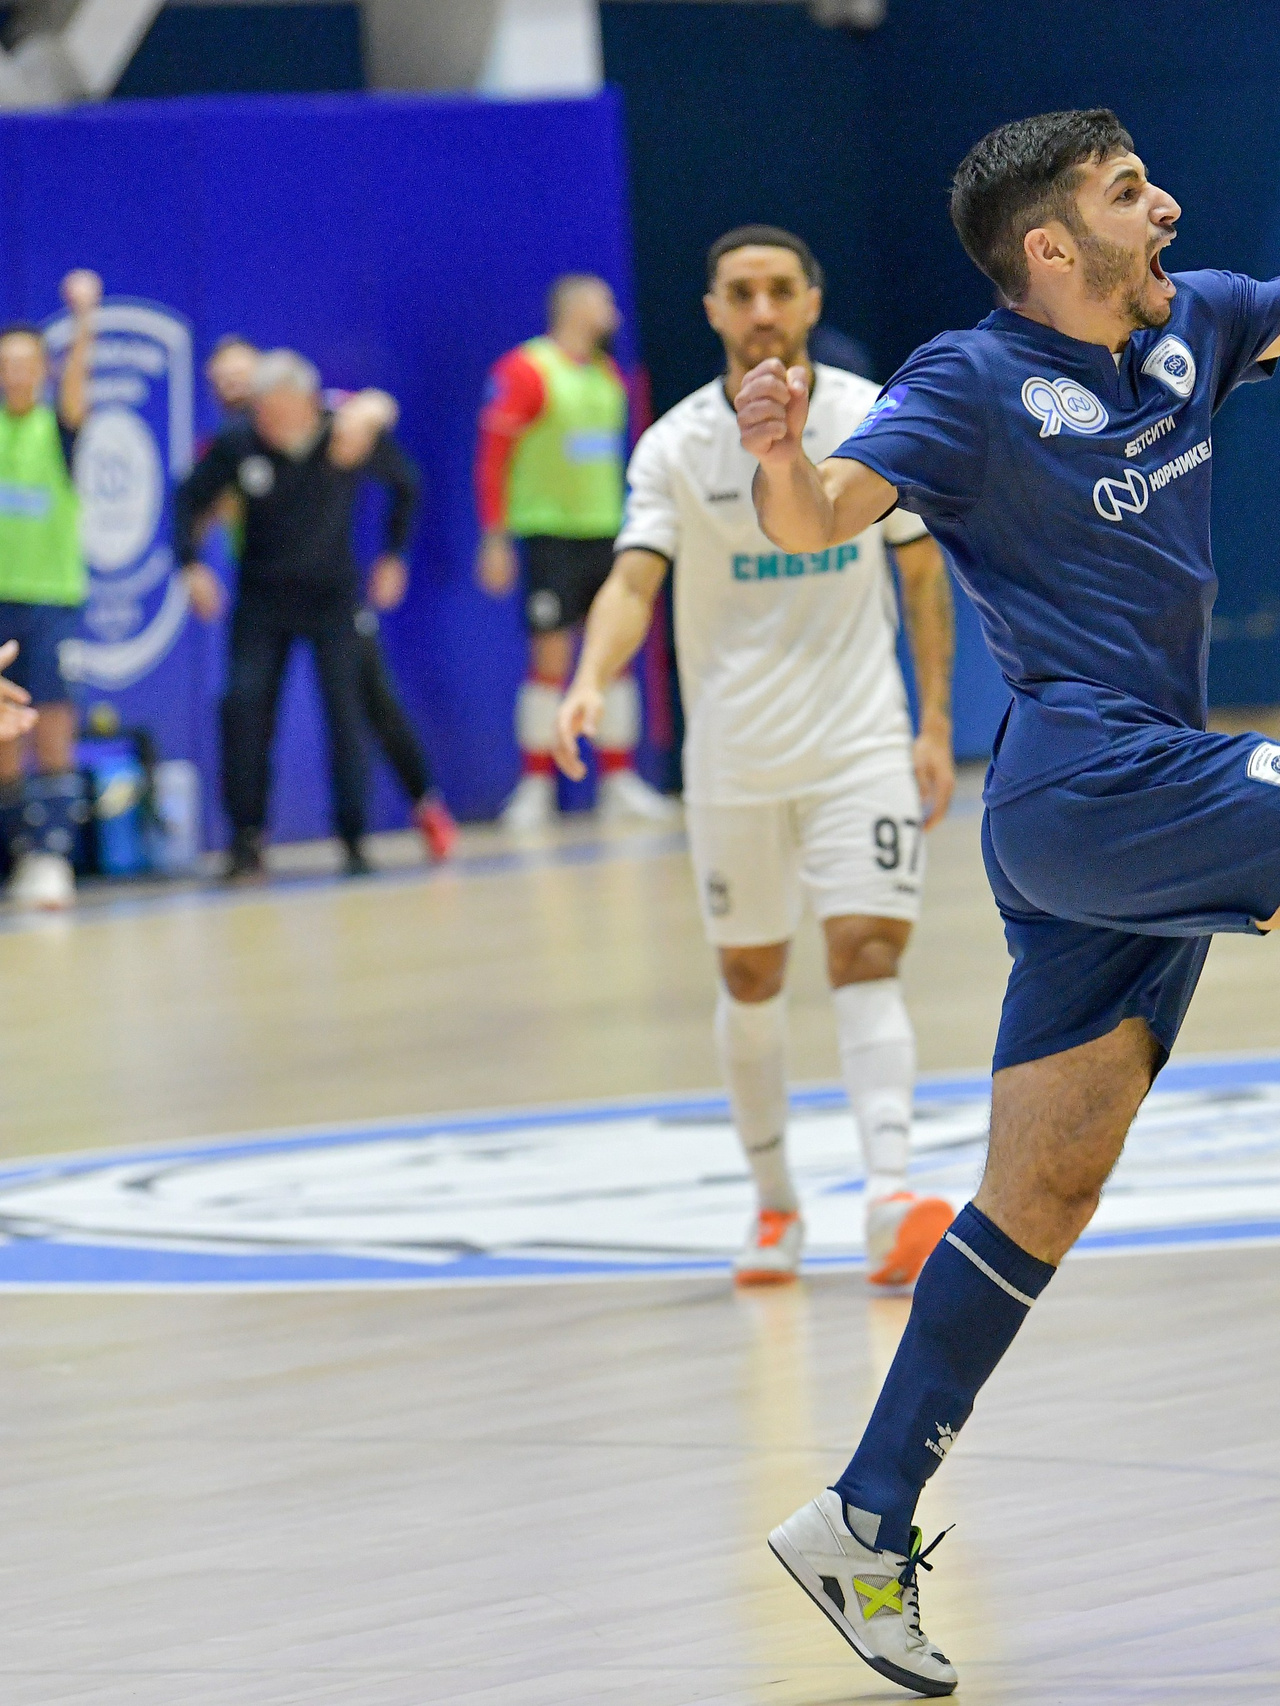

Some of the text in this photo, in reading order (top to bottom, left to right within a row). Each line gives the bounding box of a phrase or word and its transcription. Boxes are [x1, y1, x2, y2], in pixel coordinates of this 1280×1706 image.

[1021, 376, 1110, 438] 90
[731, 544, 861, 582] СИБУР
[873, 816, 922, 876] 97
